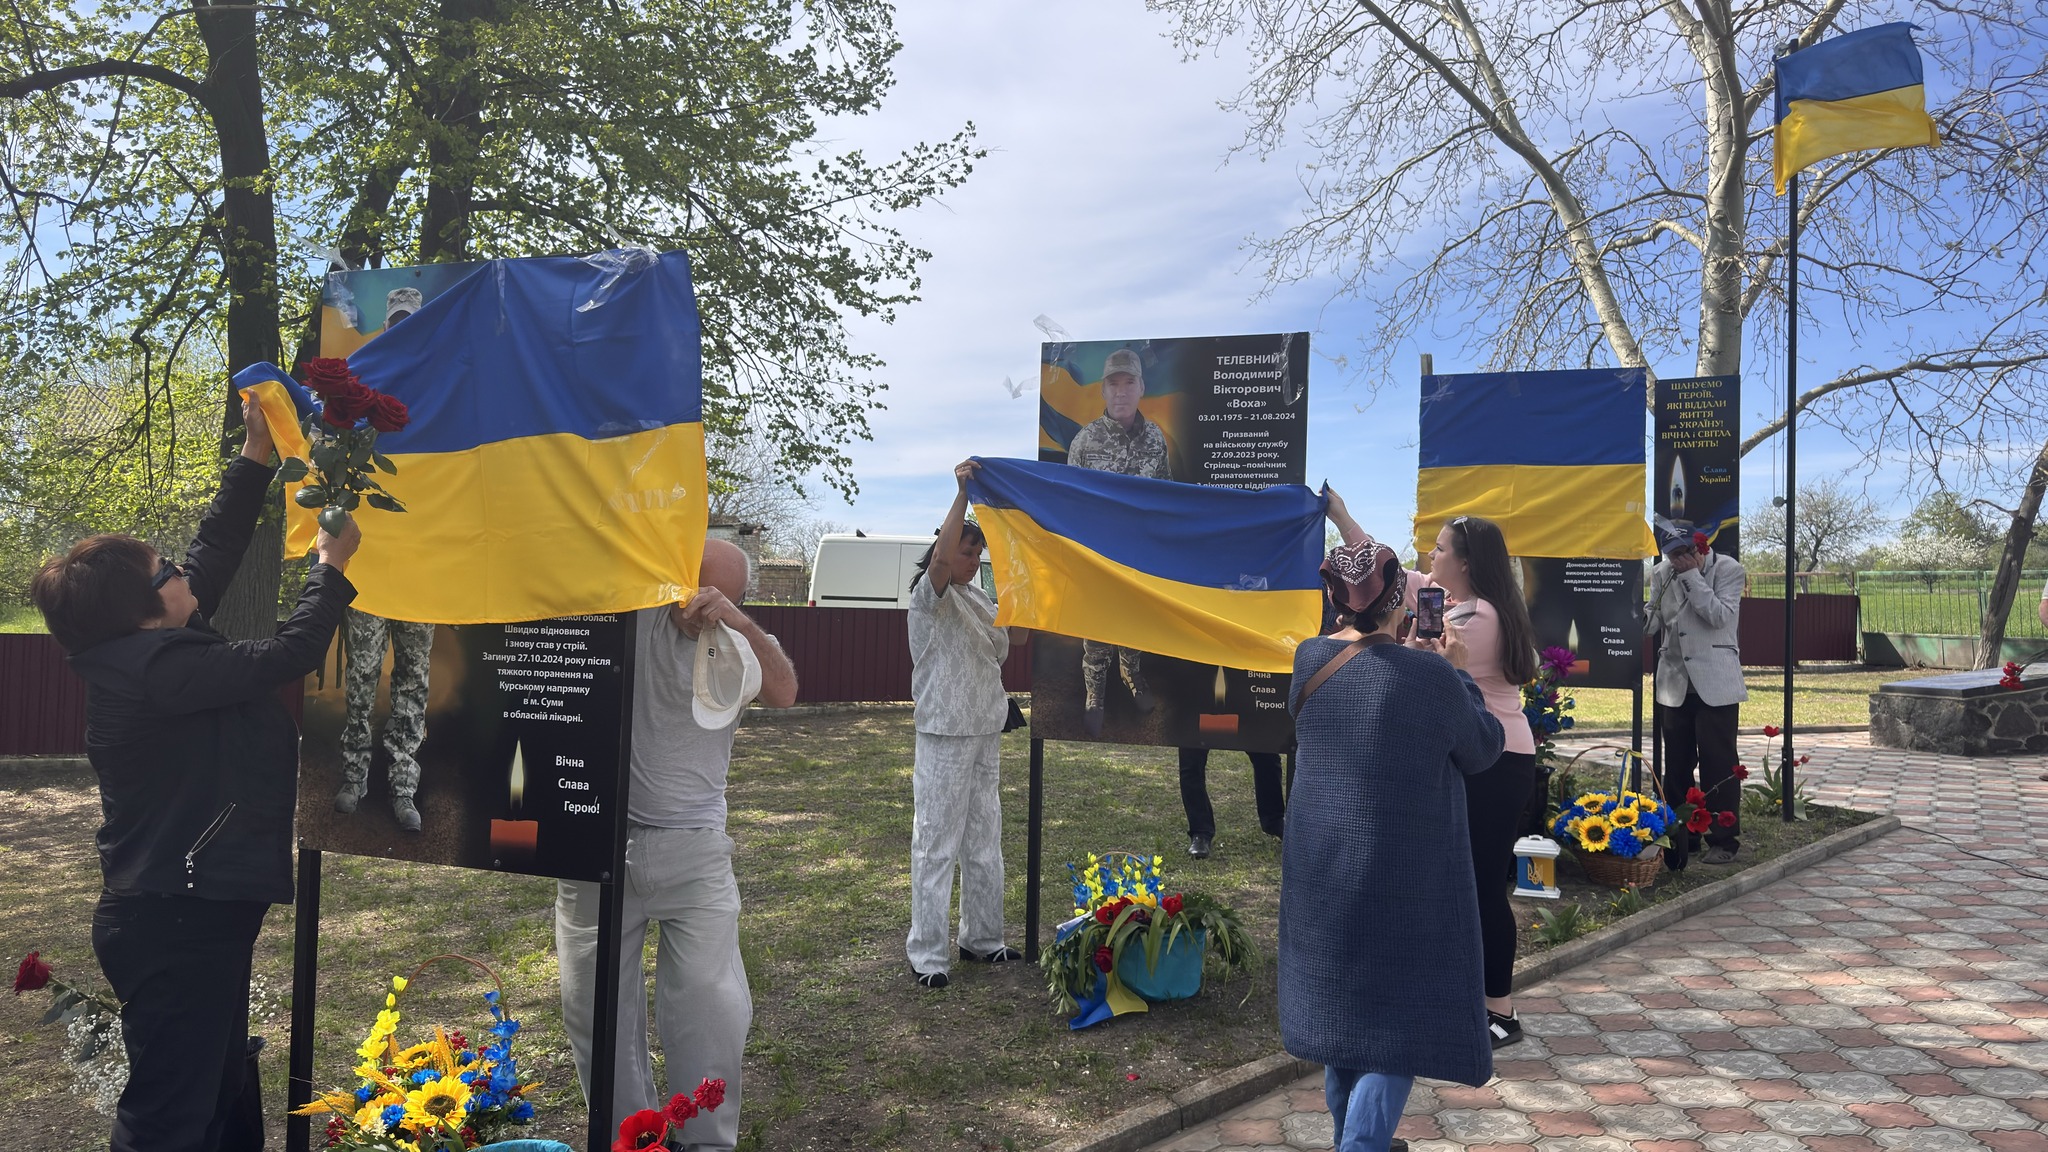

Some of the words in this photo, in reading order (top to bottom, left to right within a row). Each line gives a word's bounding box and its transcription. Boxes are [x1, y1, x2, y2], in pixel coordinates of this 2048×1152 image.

[1217, 354, 1280, 365] ТЕЛЕВНИЙ
[1213, 370, 1282, 380] Володимир
[1213, 384, 1281, 395] Вікторович
[1671, 381, 1722, 390] ШАНУЄМО
[1226, 399, 1267, 408] «Воха»
[1685, 400, 1726, 410] ВІДДАЛИ
[1679, 411, 1713, 419] ЖИТТЯ
[1679, 420, 1724, 429] УКРАЇНУ!
[1204, 462, 1240, 470] Стрілець
[1700, 476, 1731, 484] Україні!
[1244, 482, 1290, 490] відділе
[504, 625, 539, 635] Швидко
[541, 626, 590, 636] відновився
[505, 639, 508, 647] і
[510, 641, 535, 650] знову
[536, 641, 554, 649] став
[556, 643, 562, 651] у
[563, 641, 588, 651] стрій.
[482, 652, 516, 663] Загинув
[518, 653, 563, 664] 27.10.2024
[565, 657, 586, 665] року
[587, 657, 611, 666] після
[497, 668, 532, 678] тяжкого
[534, 670, 580, 680] поранення
[583, 672, 594, 680] на
[500, 681, 545, 692] Курському
[547, 685, 590, 695] напрямку
[1250, 685, 1276, 693] Слава
[524, 697, 528, 705] в
[541, 698, 563, 708] Суми
[1256, 701, 1285, 709] Герою!
[510, 710, 548, 720] обласній
[549, 712, 583, 723] лікарні.
[556, 755, 584, 768] Вічна
[558, 778, 590, 790] Слава
[564, 800, 600, 814] Герою!
